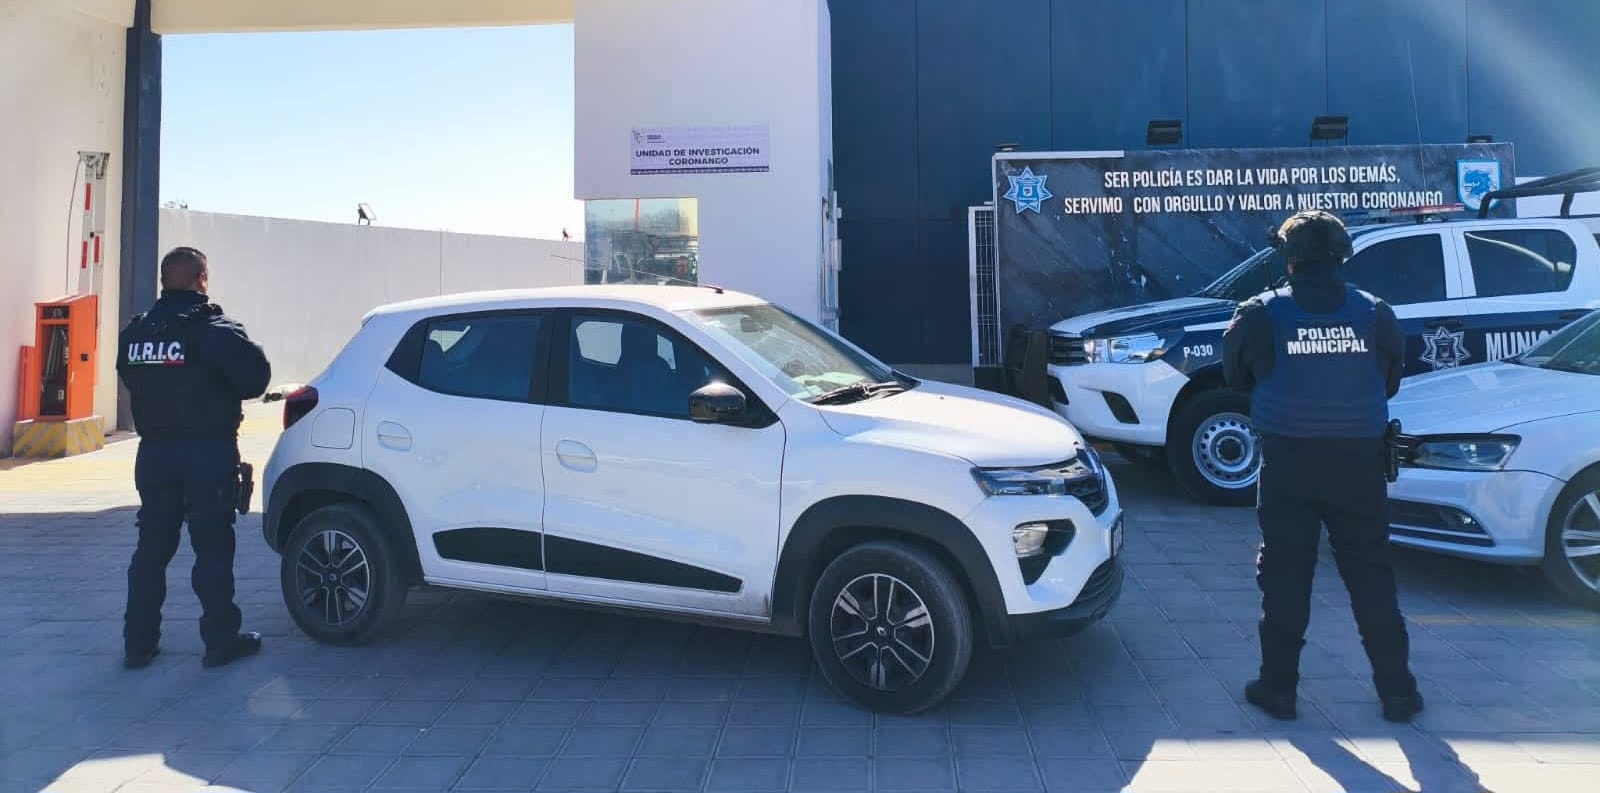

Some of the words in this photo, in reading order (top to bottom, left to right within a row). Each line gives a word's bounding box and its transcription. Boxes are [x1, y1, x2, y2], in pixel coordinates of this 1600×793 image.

[635, 149, 671, 157] UNIDAD
[674, 149, 686, 157] DE
[688, 146, 760, 156] INVESTIGACIÓN
[668, 157, 729, 166] CORONANGO
[1104, 171, 1129, 188] SER
[1133, 167, 1183, 187] POLICÍA
[1186, 170, 1202, 186] ES
[1206, 169, 1233, 186] DAR
[1237, 169, 1252, 185] LA
[1257, 168, 1288, 185] VIDA
[1291, 167, 1317, 184] POR
[1321, 166, 1346, 183] LOS
[1350, 163, 1400, 183] DEMÁS,
[1065, 197, 1123, 214] SERVIMO
[1133, 196, 1161, 213] CON
[1164, 195, 1223, 212] ORGULLO
[1227, 195, 1235, 211] Y
[1239, 193, 1281, 211] VALOR
[1285, 193, 1294, 210] A
[1298, 192, 1358, 210] NUESTRO
[1362, 191, 1442, 209] CORONANGO
[1297, 325, 1355, 340] POLICÍA
[128, 341, 184, 361] U.R.I.C.
[1184, 345, 1213, 358] P-030
[1287, 339, 1368, 354] MUNICIPAL
[1486, 330, 1558, 362] MUNI
